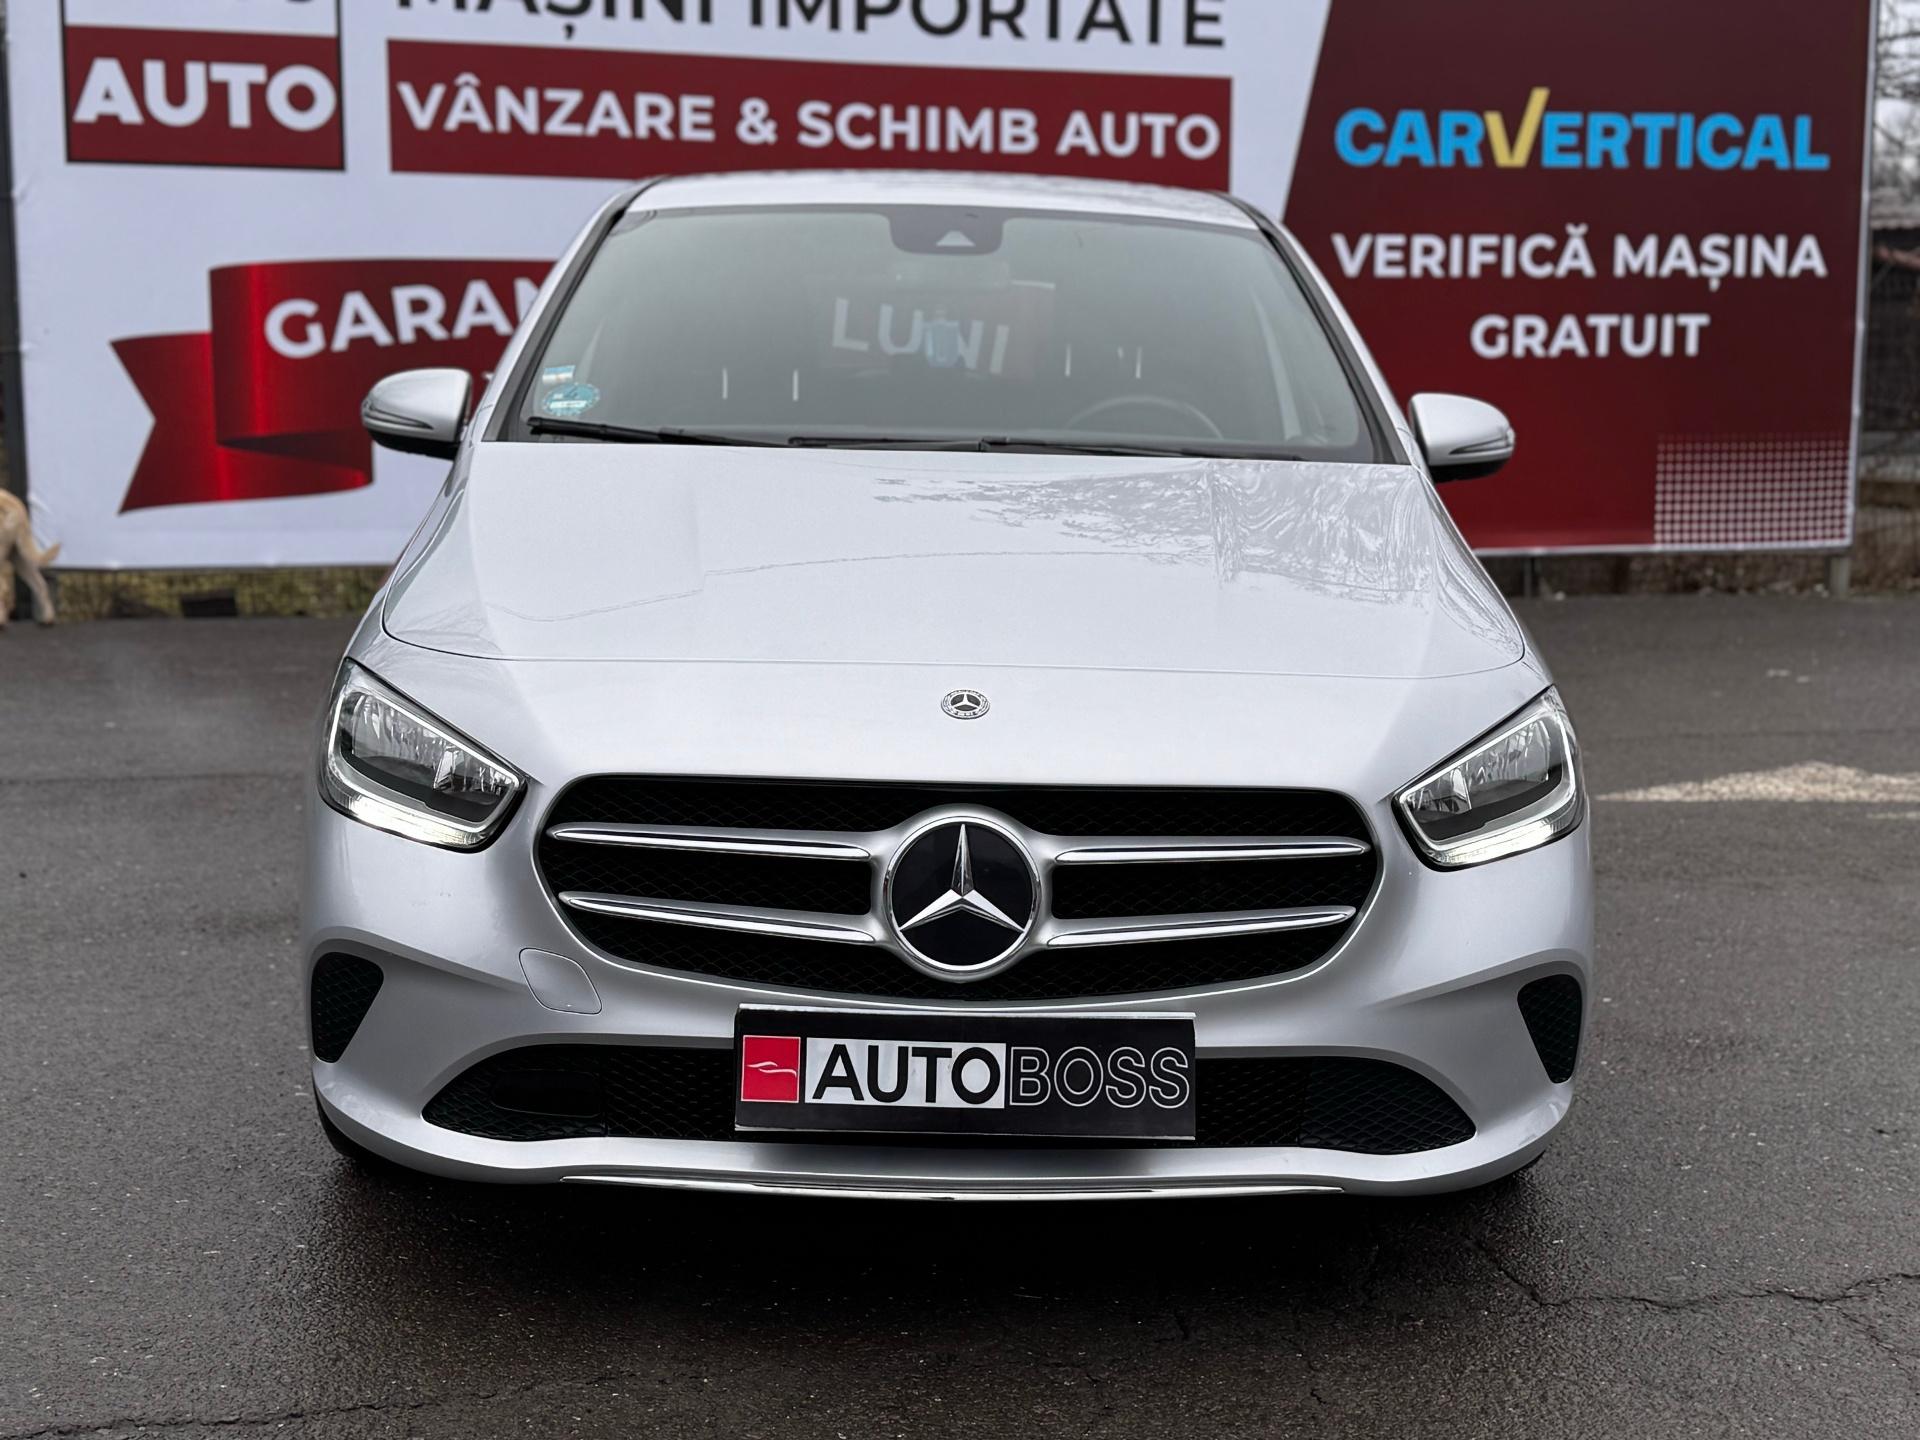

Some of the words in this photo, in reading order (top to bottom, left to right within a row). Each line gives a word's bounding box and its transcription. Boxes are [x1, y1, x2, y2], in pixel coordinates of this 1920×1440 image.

[73, 58, 337, 131] AUTO
[397, 73, 716, 142] VÂNZARE
[736, 98, 778, 144] &
[798, 101, 1039, 154] SCHIMB
[1056, 111, 1220, 159] AUTO
[1335, 87, 1830, 169] CARVERTICAL
[1332, 224, 1596, 278] VERIFICĂ
[1614, 234, 1827, 291] MAȘINA
[1471, 314, 1710, 358] GRATUIT
